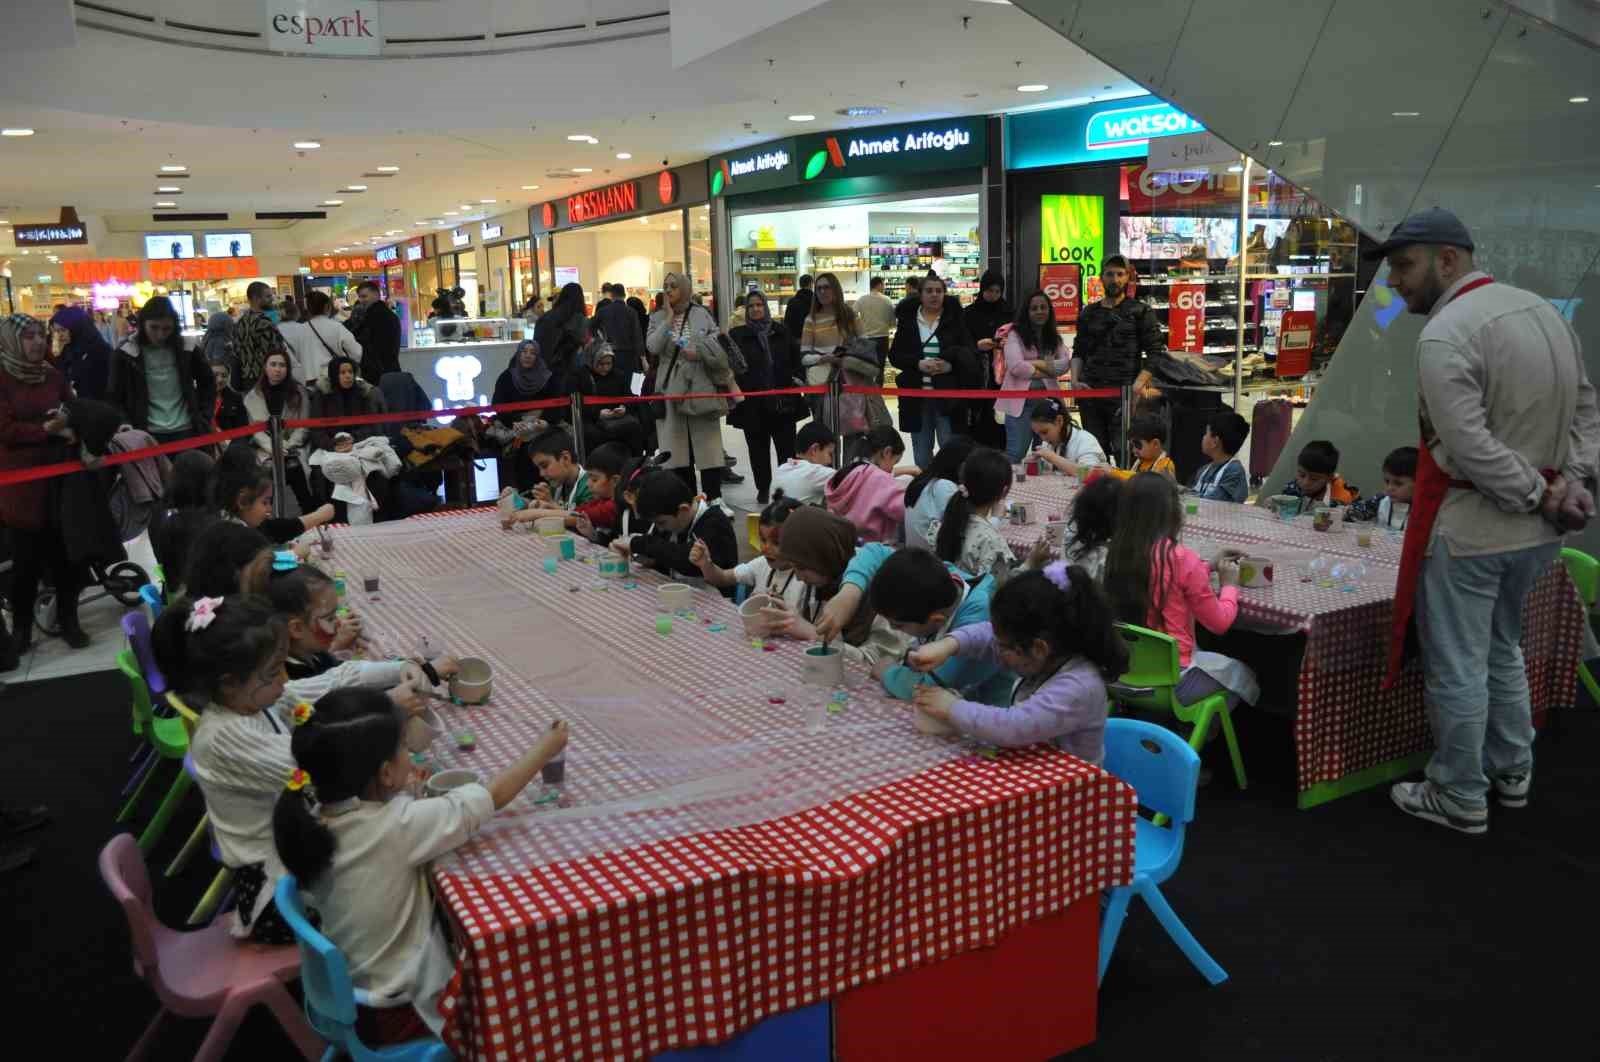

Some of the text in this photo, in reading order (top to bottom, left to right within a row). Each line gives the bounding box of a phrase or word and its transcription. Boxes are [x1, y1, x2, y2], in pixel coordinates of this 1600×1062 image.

[272, 10, 373, 44] espark
[1104, 111, 1200, 137] watson
[848, 128, 970, 157] Ahmet Arifoğlu
[730, 157, 755, 177] Ahmet
[567, 181, 637, 222] ROSSMANN
[1050, 246, 1095, 262] LOOK
[1043, 283, 1078, 302] 60
[1177, 290, 1206, 310] 60
